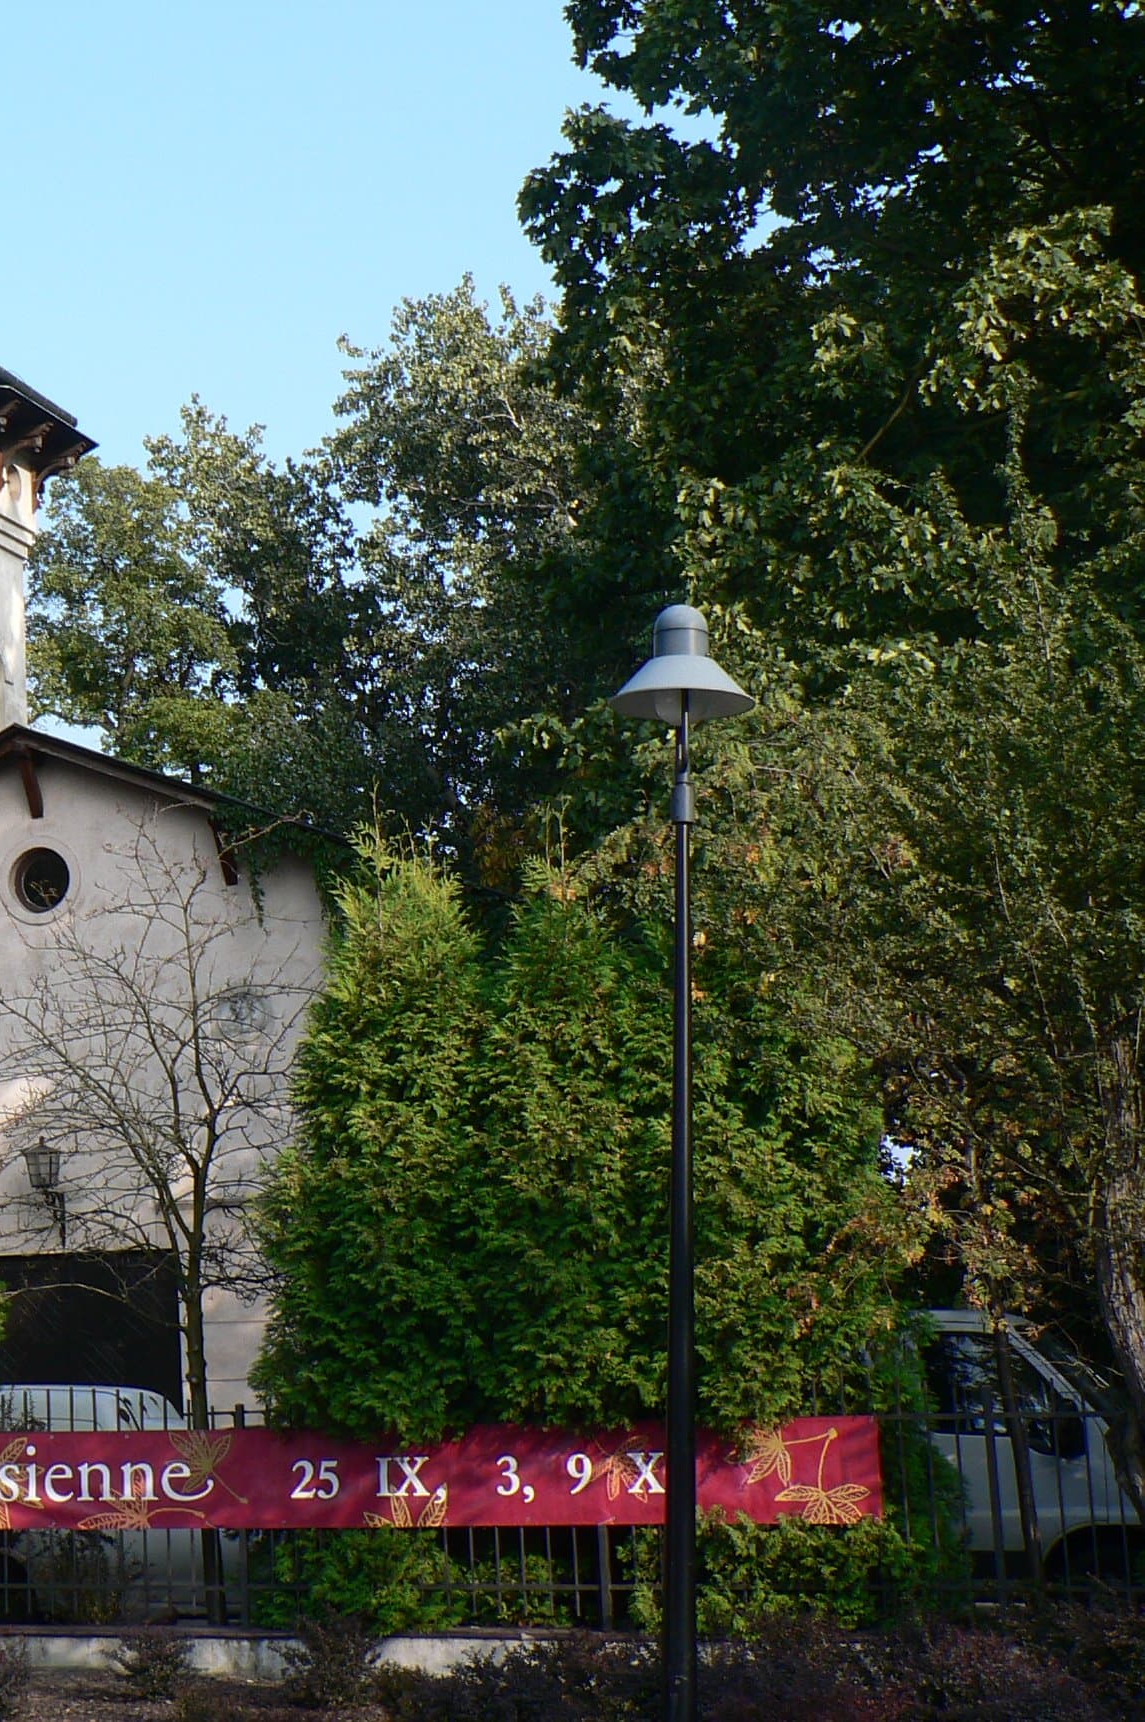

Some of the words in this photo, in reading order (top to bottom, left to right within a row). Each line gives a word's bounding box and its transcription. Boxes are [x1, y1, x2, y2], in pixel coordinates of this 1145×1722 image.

[290, 1460, 340, 1499] 25
[375, 1456, 448, 1504] IX,
[496, 1456, 535, 1504] 3,
[566, 1453, 592, 1495] 9
[626, 1452, 666, 1494] X
